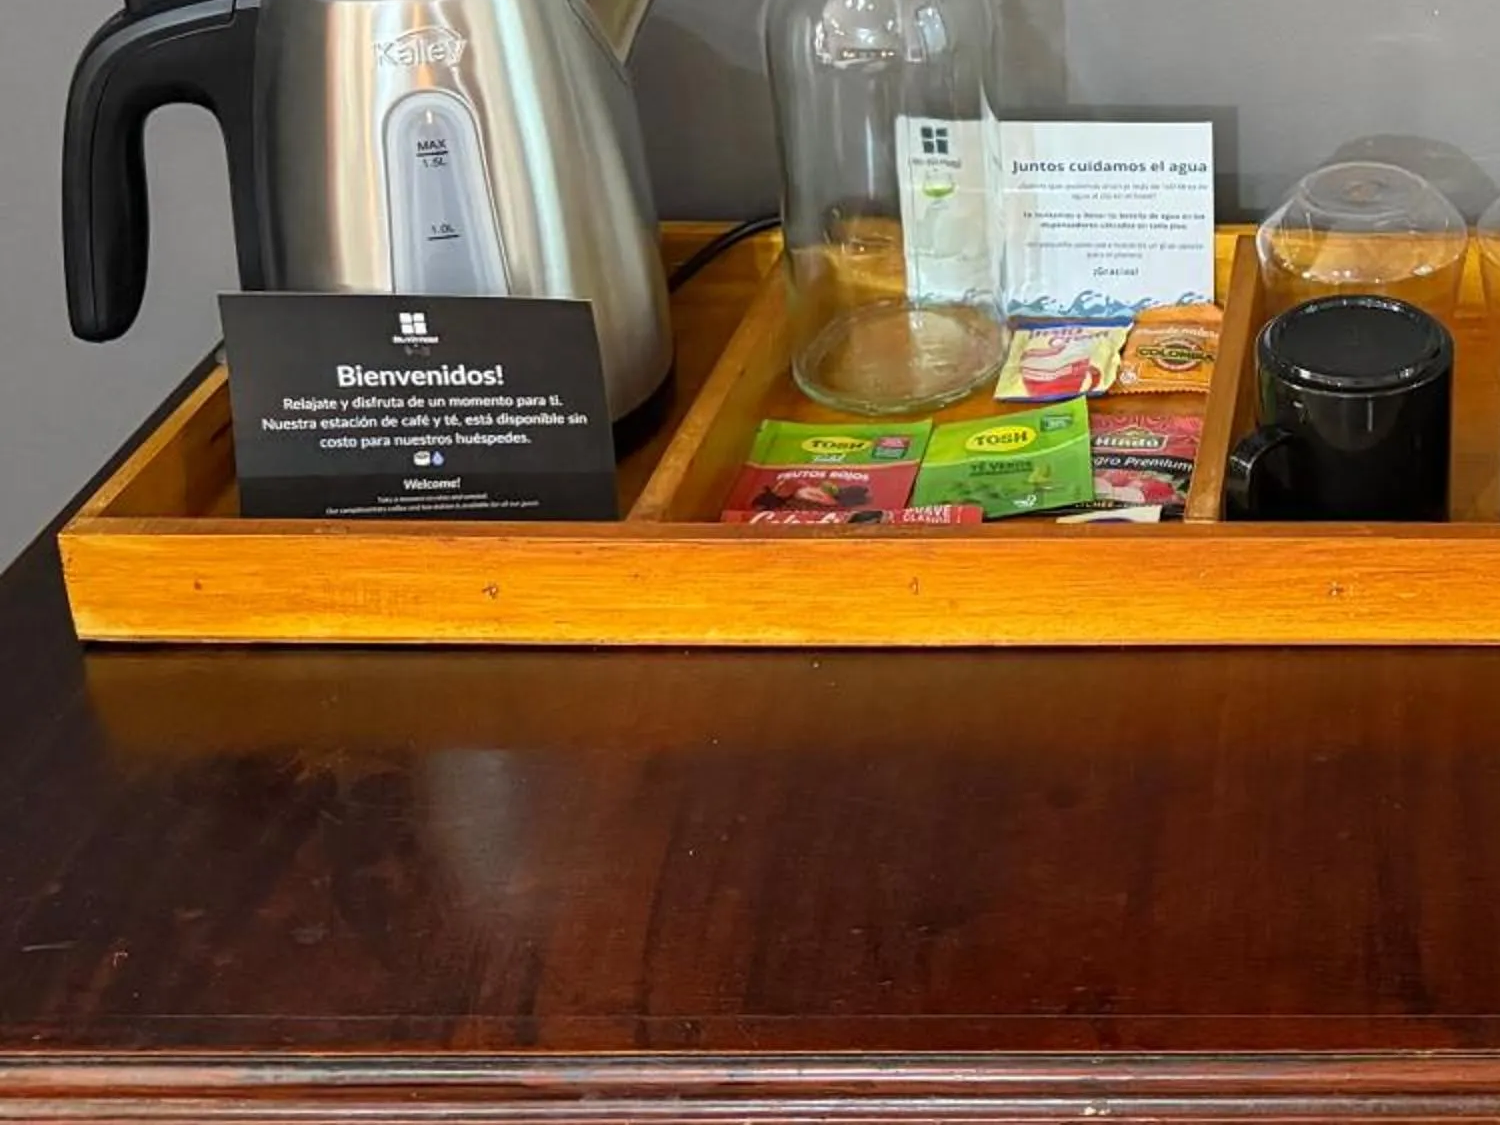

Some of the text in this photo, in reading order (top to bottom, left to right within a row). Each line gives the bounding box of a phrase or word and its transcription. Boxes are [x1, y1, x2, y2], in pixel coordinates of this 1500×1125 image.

[417, 138, 447, 152] MAX
[422, 157, 447, 168] 1.5L
[1012, 160, 1208, 175] Juntos cuidamos el agua
[336, 364, 505, 388] Bienvenidos!
[283, 394, 564, 411] Relajate y disfruta de un momento para ti.
[261, 418, 317, 431] Nuestra
[320, 415, 378, 429] estación
[381, 415, 398, 427] de
[401, 413, 430, 427] café
[432, 416, 442, 428] y
[464, 413, 494, 425] está
[496, 413, 565, 427] disponible
[567, 413, 588, 424] sin
[319, 432, 533, 449] costo para nuestros huéspedes.
[811, 439, 865, 451] TOSH
[973, 430, 1029, 446] TOSH
[1093, 455, 1193, 472] gro Premium
[403, 477, 462, 490] Welcome!
[776, 470, 870, 482] FRUTOS ROJOS
